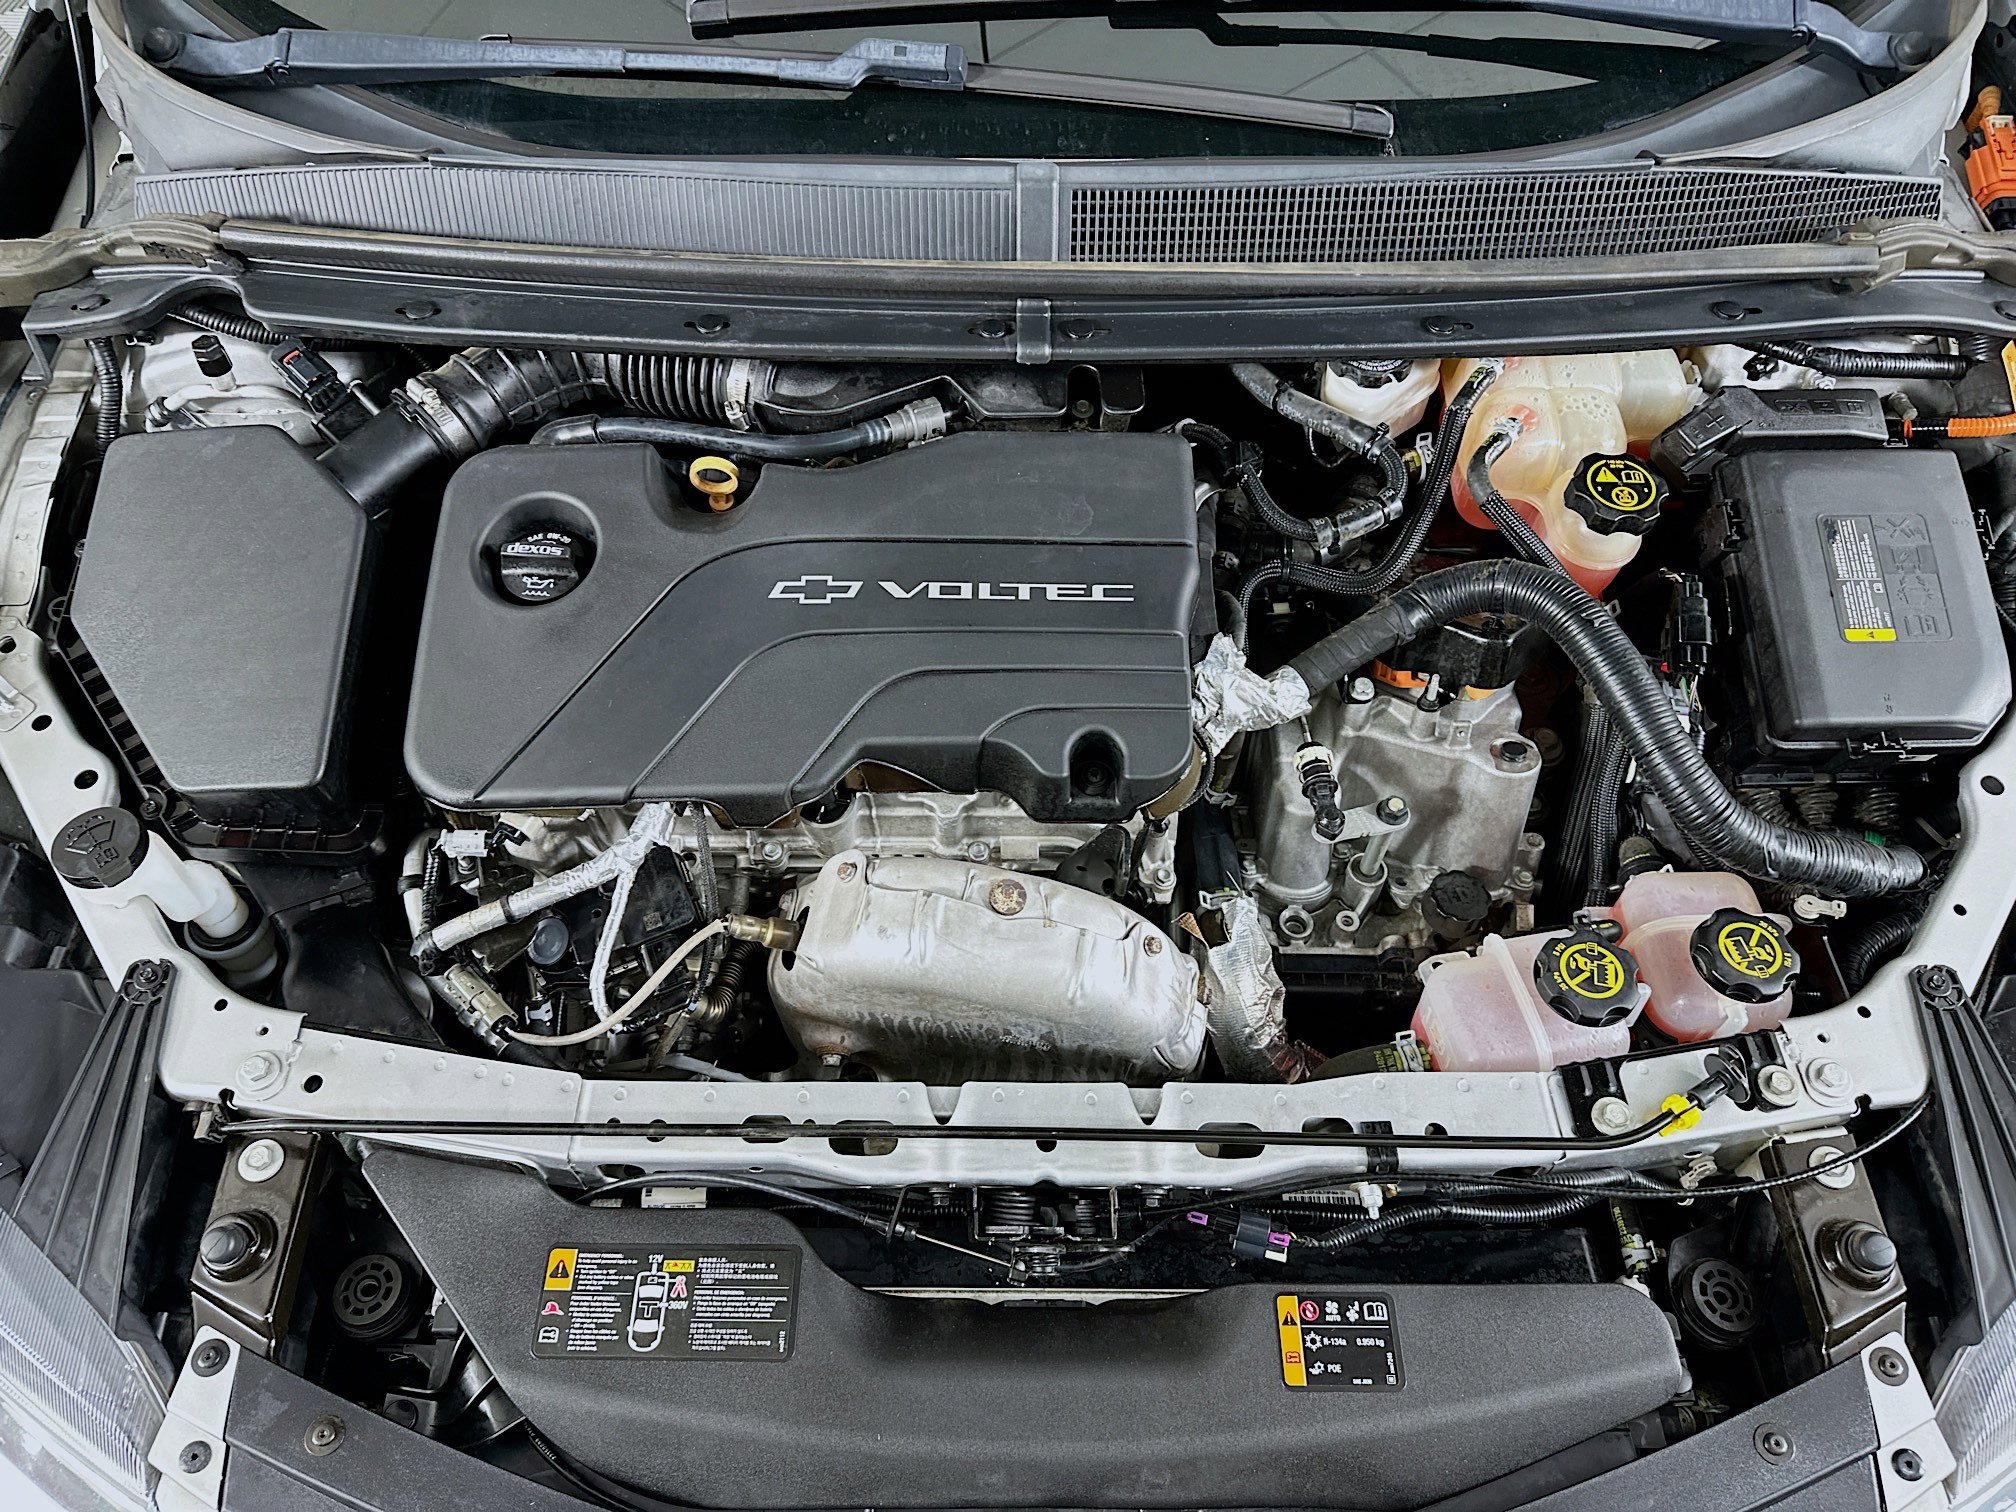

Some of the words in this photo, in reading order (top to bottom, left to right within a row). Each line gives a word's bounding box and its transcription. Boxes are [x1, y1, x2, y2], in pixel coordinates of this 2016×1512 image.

[527, 533, 544, 543] SAE
[546, 532, 572, 544] 0W-20
[506, 542, 565, 556] dexos
[877, 581, 1135, 602] VOLTEC
[648, 1254, 664, 1263] 12V
[668, 1300, 689, 1309] 360V
[1325, 1314, 1342, 1322] AUTO
[1323, 1337, 1347, 1346] R-134a
[1356, 1337, 1375, 1346] 0.950
[1375, 1337, 1385, 1348] kg
[1327, 1363, 1342, 1373] POE
